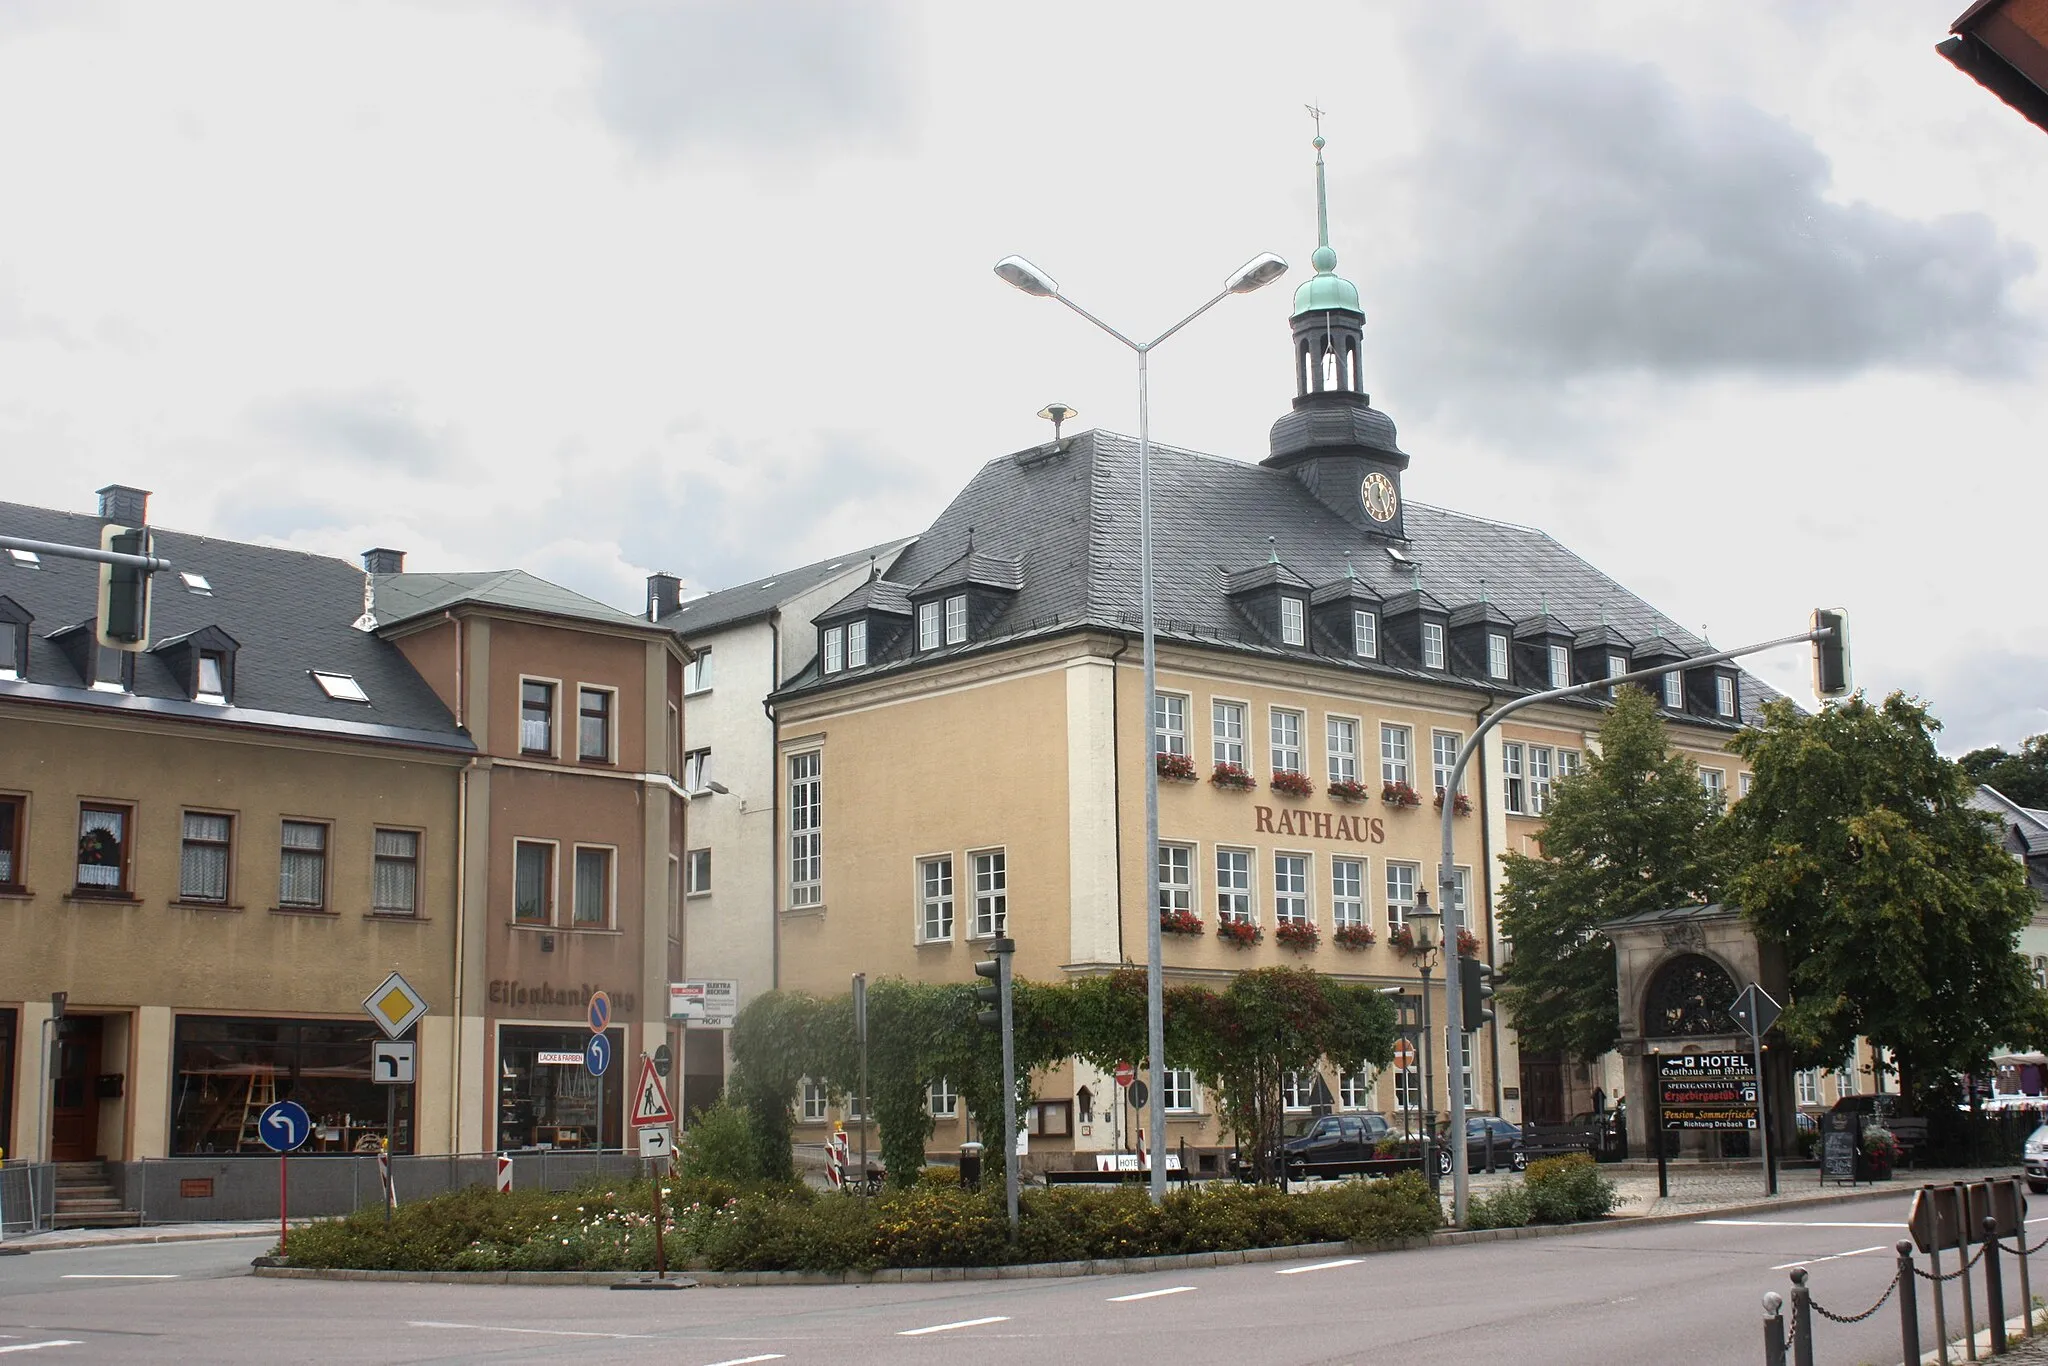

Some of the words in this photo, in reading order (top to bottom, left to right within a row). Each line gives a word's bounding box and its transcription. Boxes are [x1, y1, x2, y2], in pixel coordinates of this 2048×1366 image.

[1254, 806, 1385, 844] RATHAUS
[1700, 1056, 1748, 1067] HOTEL
[1662, 1067, 1704, 1075] Gasthaus
[1724, 1067, 1754, 1075] Markt
